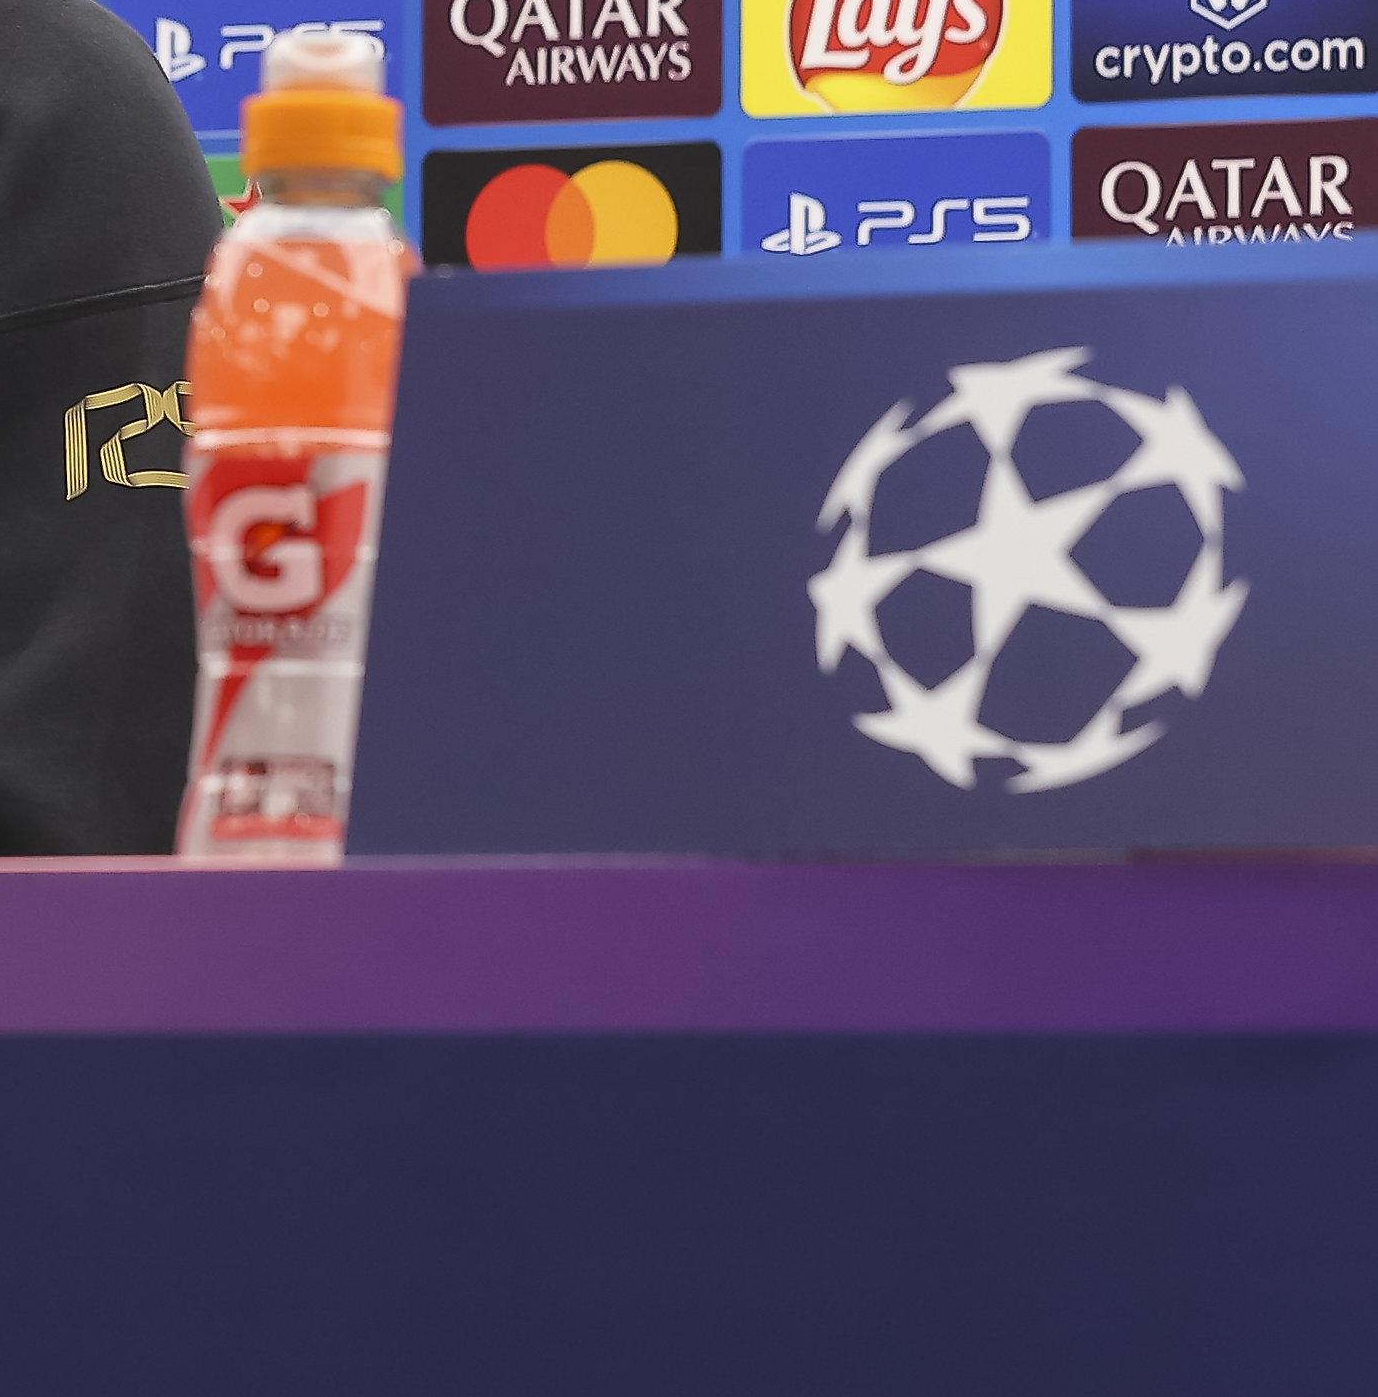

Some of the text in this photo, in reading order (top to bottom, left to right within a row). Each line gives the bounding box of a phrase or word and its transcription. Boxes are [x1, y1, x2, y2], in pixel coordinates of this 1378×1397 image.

[504, 39, 692, 86] AIRWAYS
[1094, 35, 1366, 85] crypto.com
[855, 195, 1032, 247] PS5
[1101, 155, 1354, 235] QATAR
[210, 484, 323, 613] G
